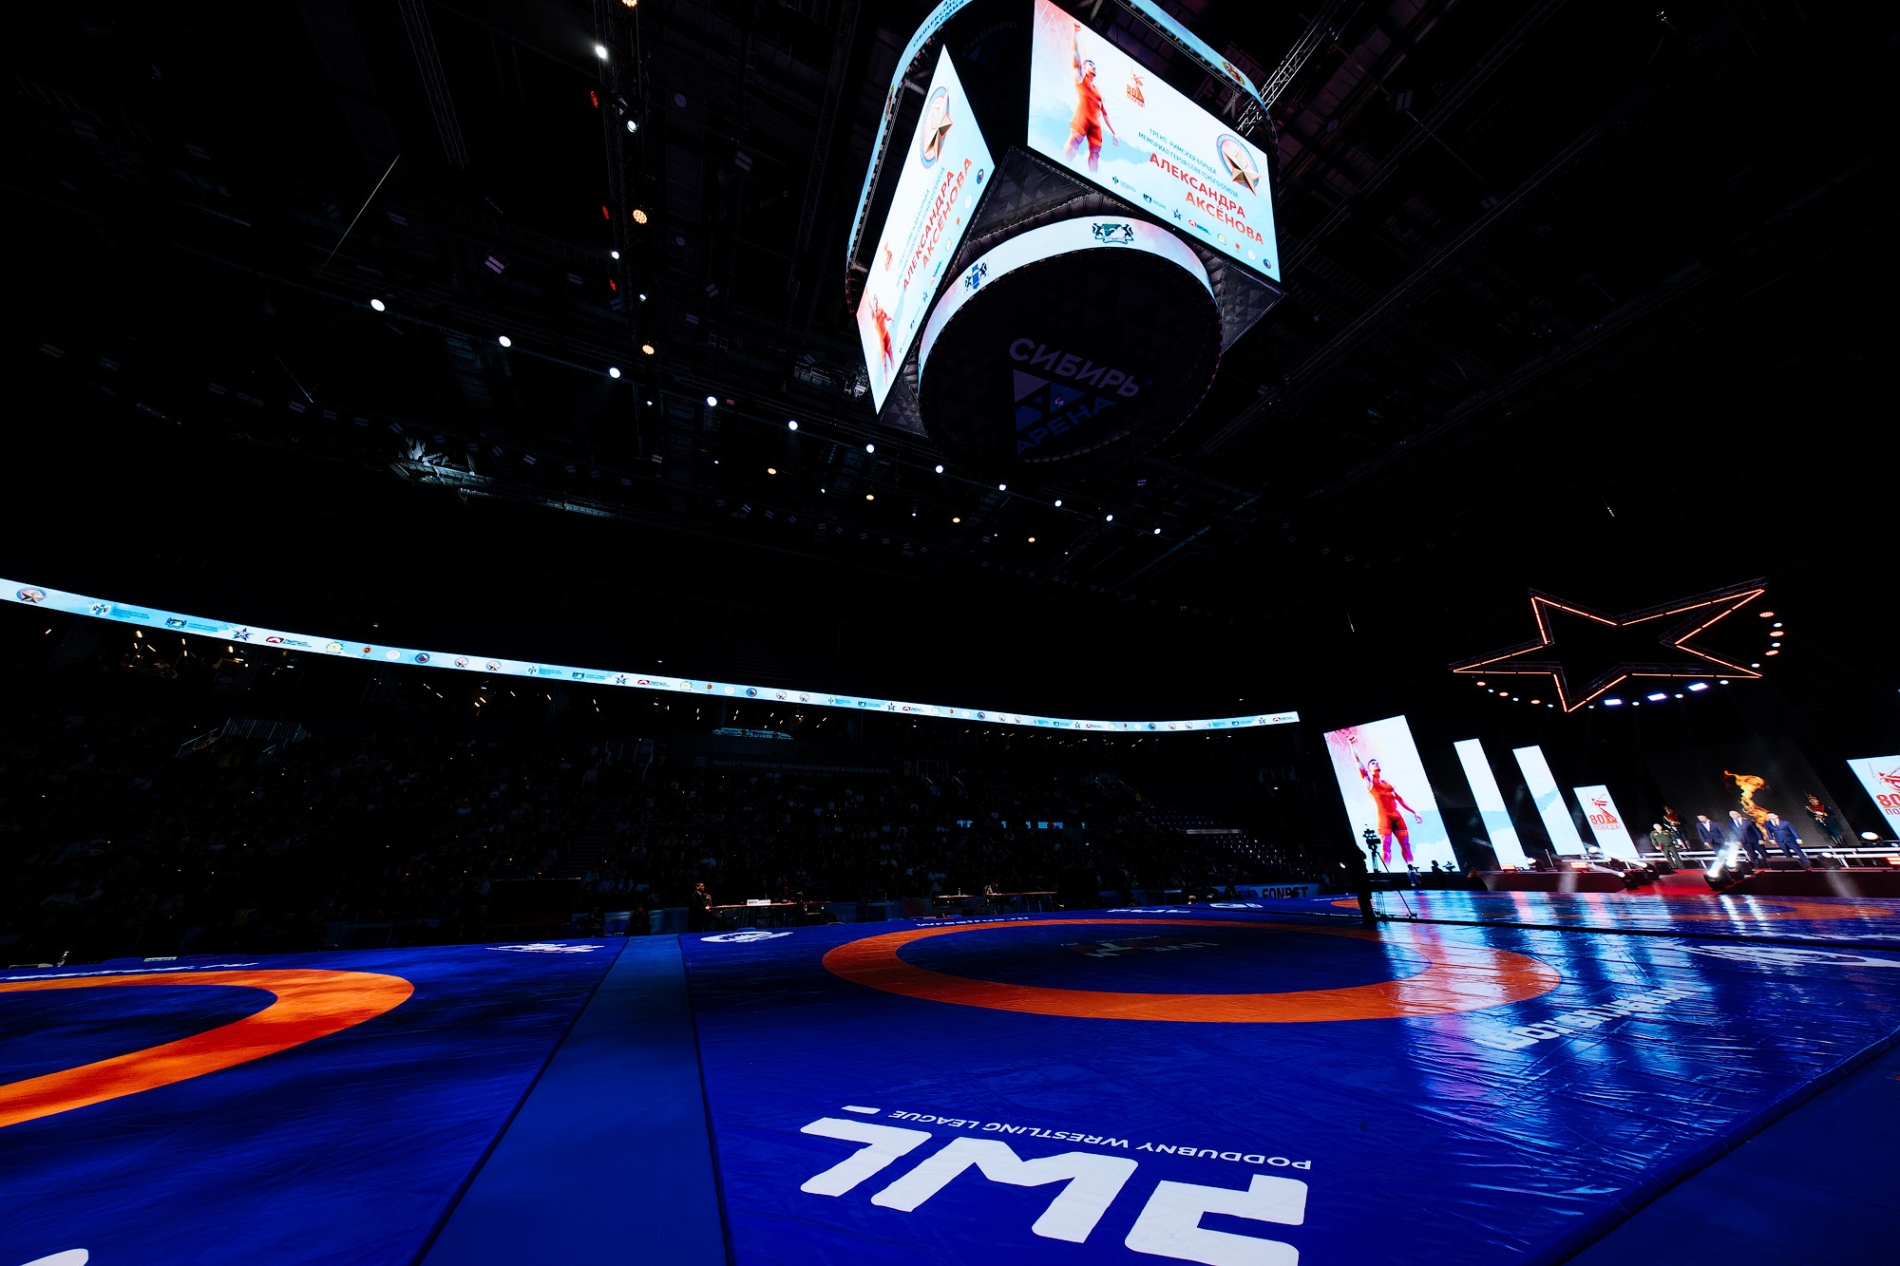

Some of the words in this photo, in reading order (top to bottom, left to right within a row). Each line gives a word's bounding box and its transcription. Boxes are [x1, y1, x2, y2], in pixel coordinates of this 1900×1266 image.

[922, 158, 972, 270] АКСЁНОВА
[1149, 153, 1246, 218] АЛЕКСАНДРА
[903, 171, 955, 291] АЛЕКСАНДРА
[1185, 191, 1264, 245] АКСЁНОВА
[1009, 337, 1140, 398] СИБИРЬ
[1015, 395, 1118, 456] АРЕНА
[1589, 814, 1606, 825] 80
[1876, 793, 1900, 807] 80
[888, 1110, 980, 1129] LEAGUE
[982, 1122, 1129, 1149] WRESTLING
[1136, 1142, 1312, 1170] PODDUBNY
[800, 1116, 1309, 1266] PWL
